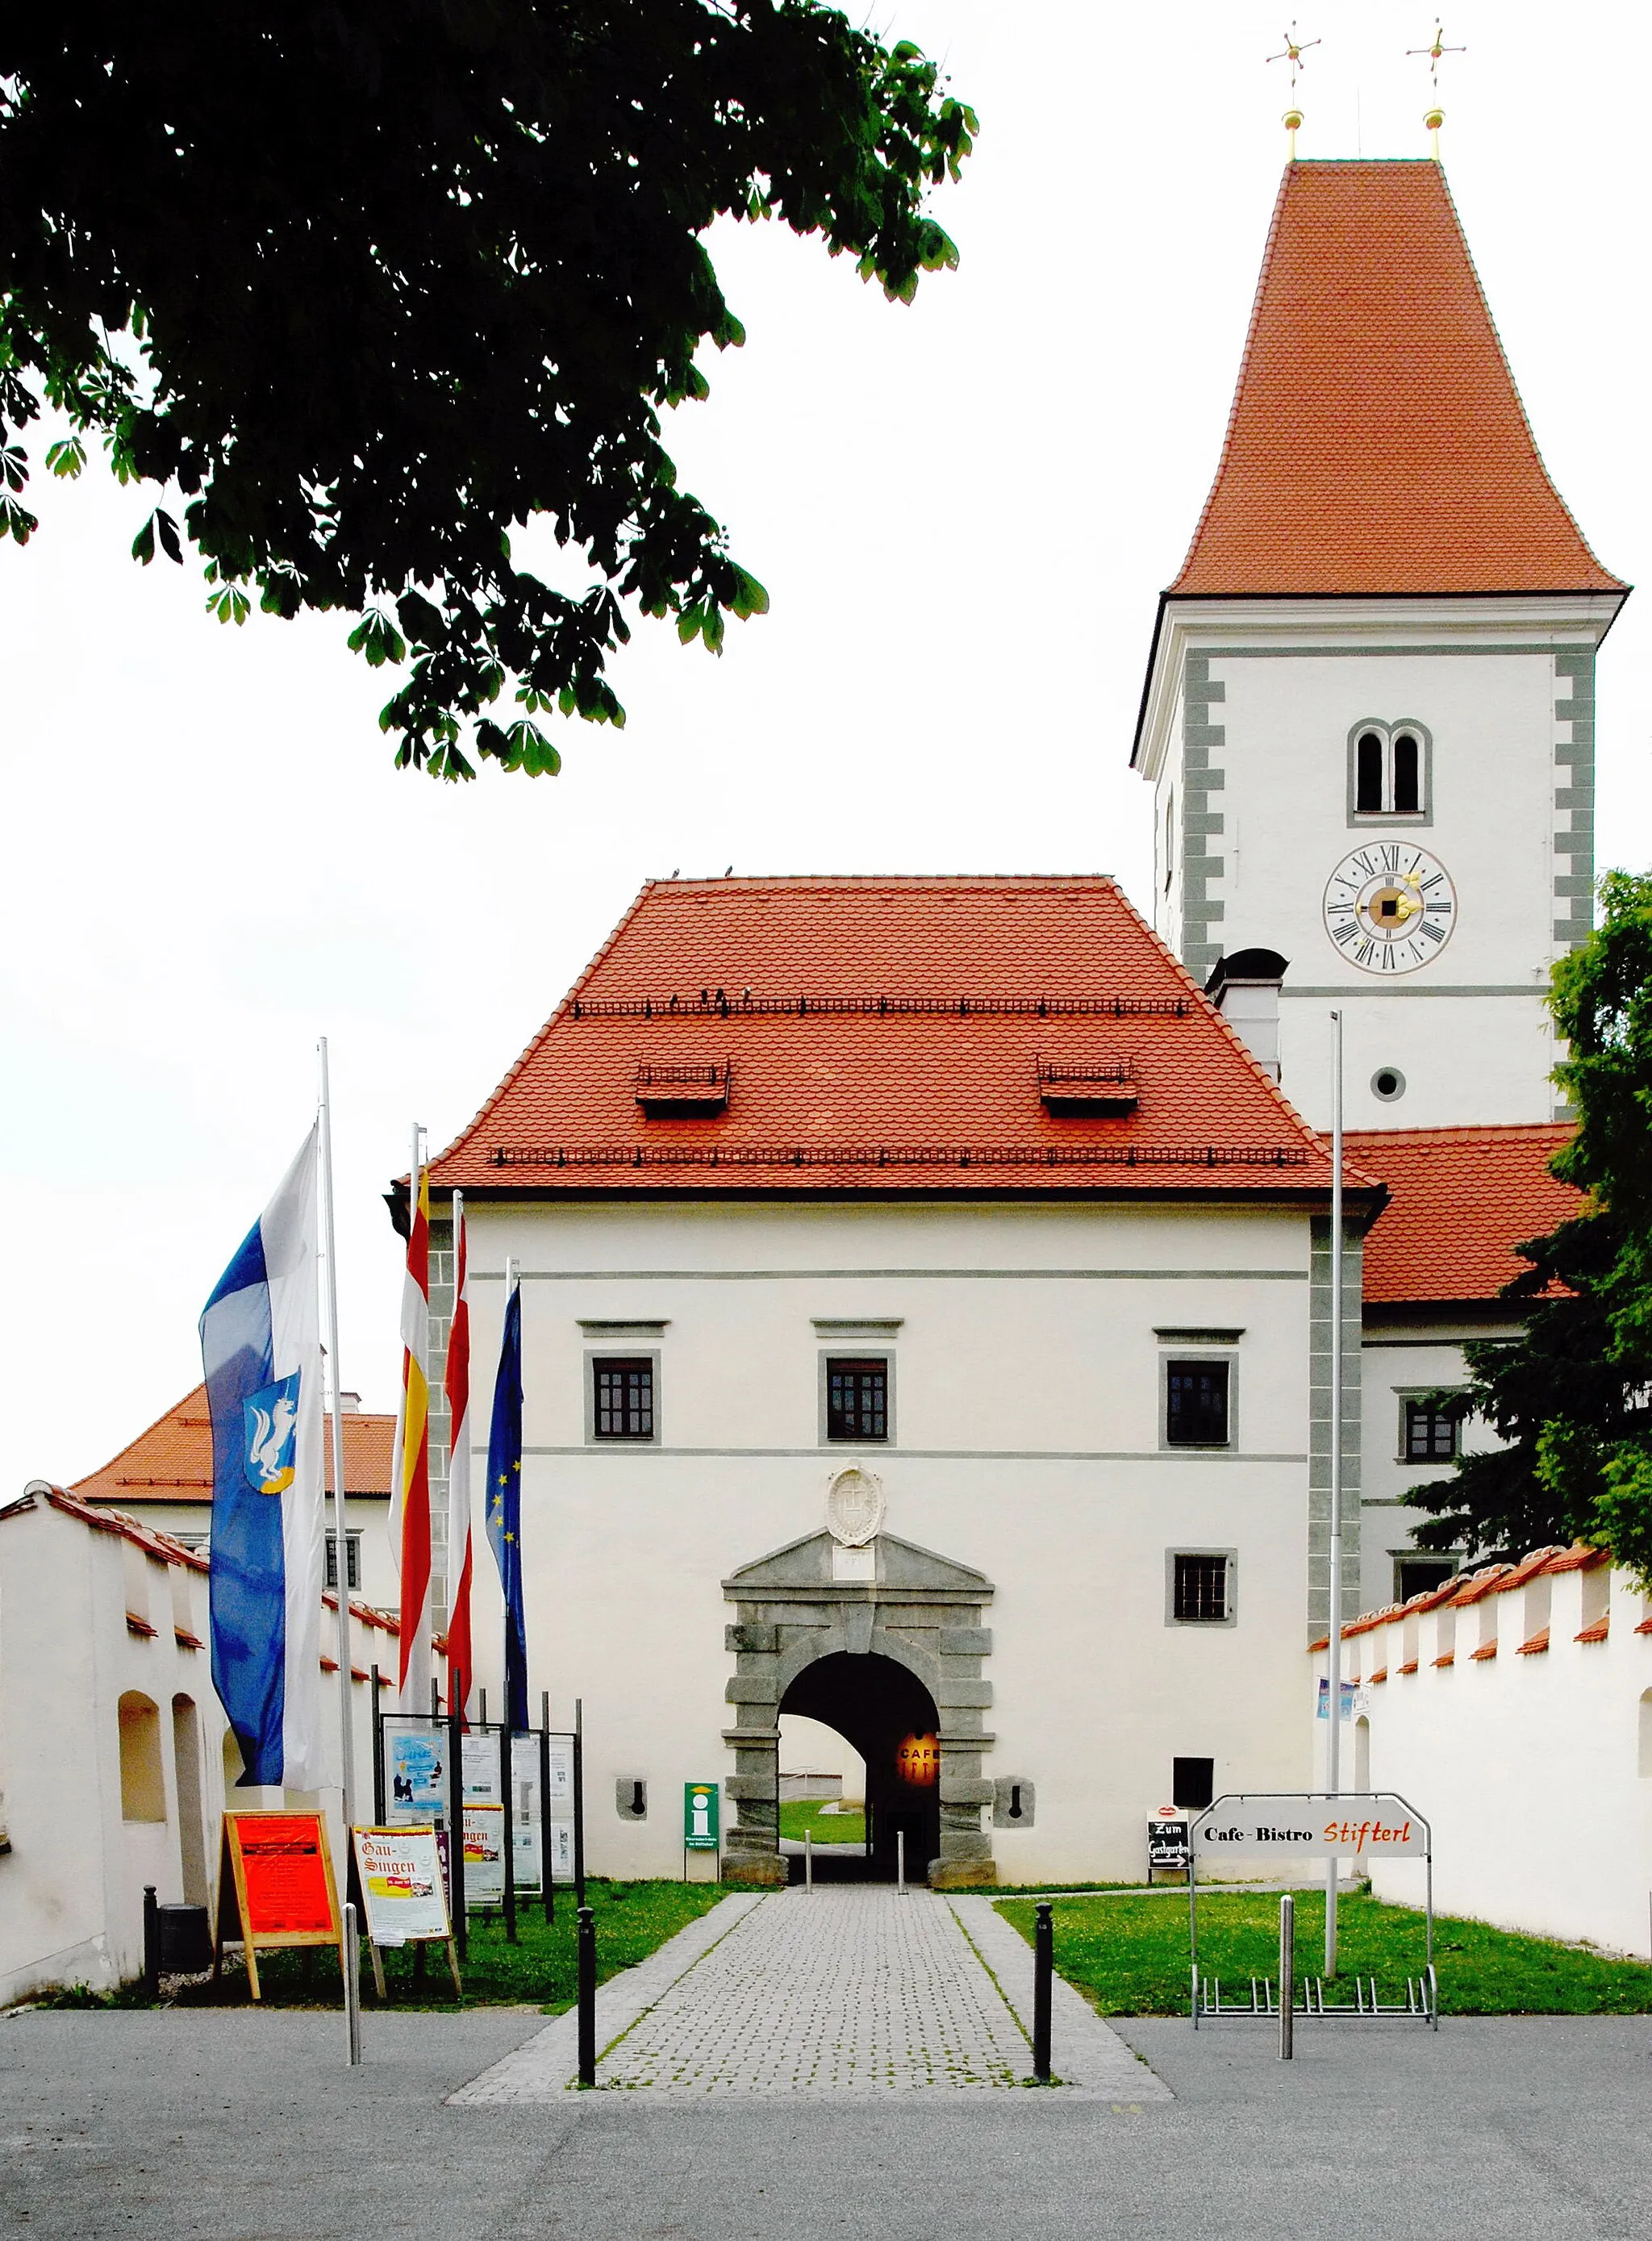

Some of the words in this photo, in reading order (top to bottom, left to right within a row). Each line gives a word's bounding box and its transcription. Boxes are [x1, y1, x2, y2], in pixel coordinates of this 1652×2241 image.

[1351, 851, 1376, 879] XI
[1379, 845, 1400, 872] XII
[1333, 874, 1359, 894] X
[1420, 873, 1445, 891] II
[1425, 902, 1451, 913] III
[1382, 944, 1395, 969] VI
[1407, 939, 1424, 963] V
[900, 1748, 941, 1759] CAFE
[1154, 1822, 1182, 1834] Zum
[1323, 1821, 1411, 1854] Stifterl
[362, 1841, 397, 1856] Gau-
[1148, 1840, 1189, 1858] Gastgarten
[364, 1857, 415, 1875] Singen
